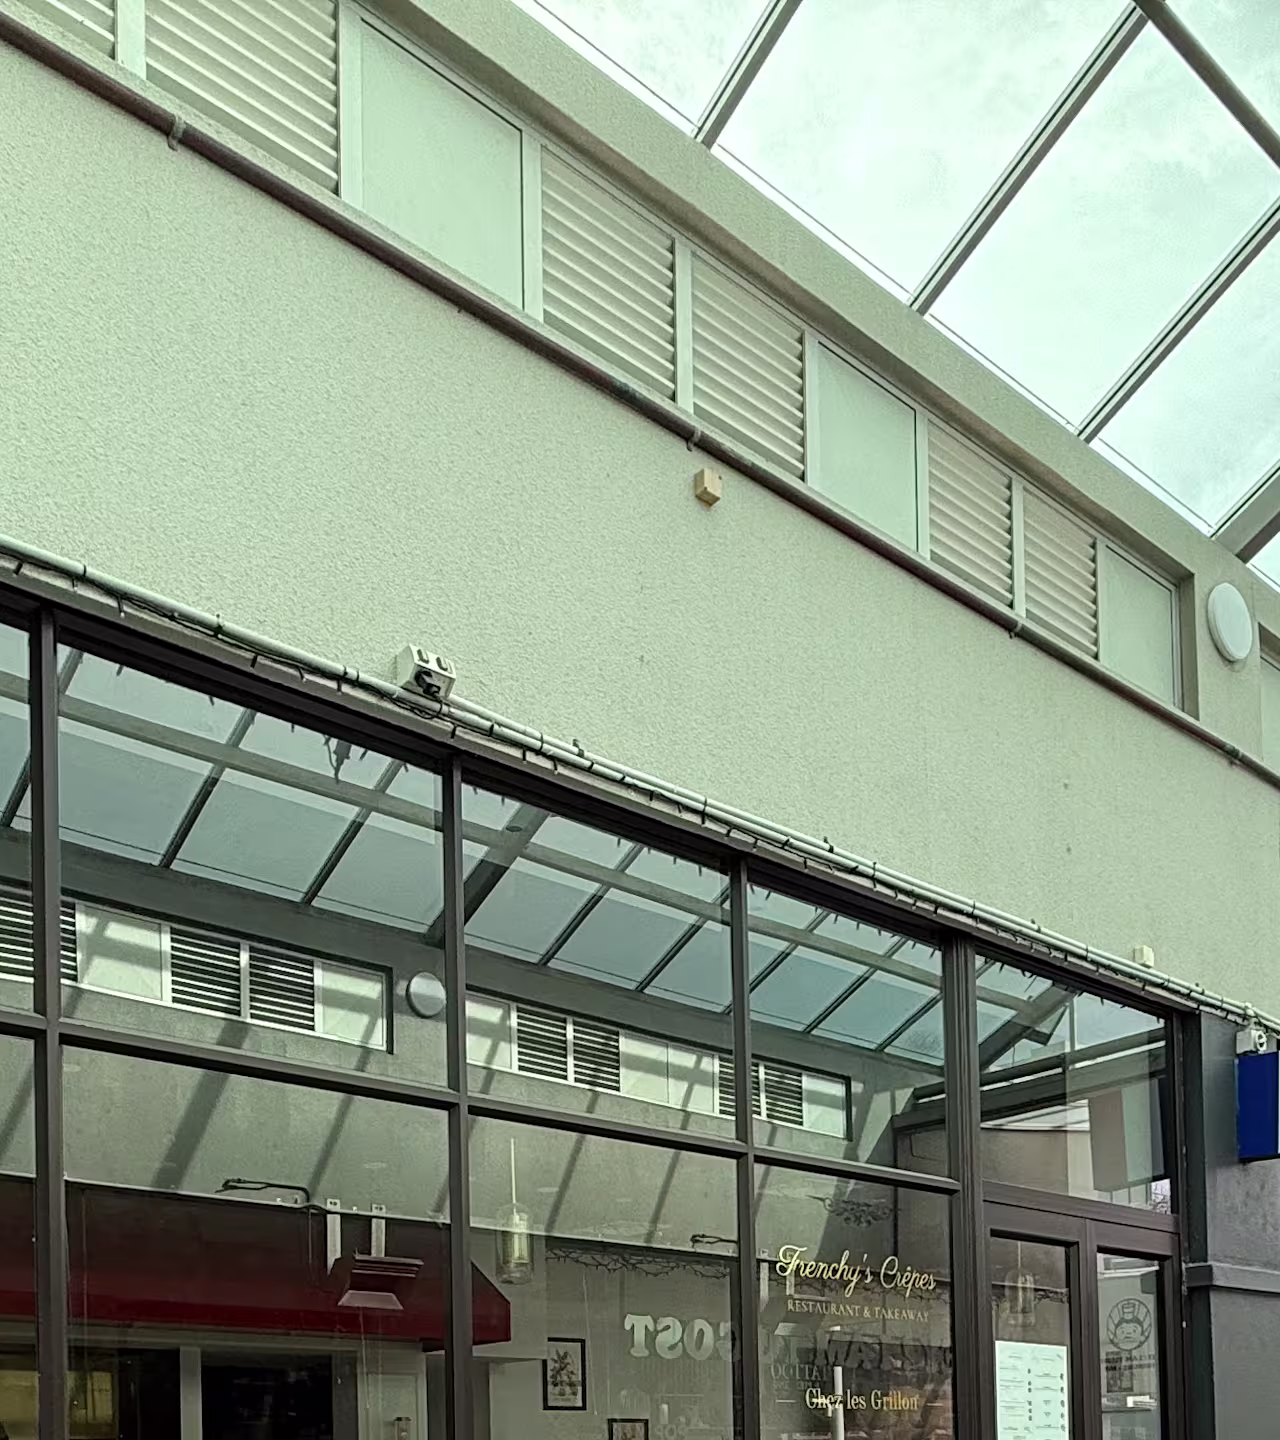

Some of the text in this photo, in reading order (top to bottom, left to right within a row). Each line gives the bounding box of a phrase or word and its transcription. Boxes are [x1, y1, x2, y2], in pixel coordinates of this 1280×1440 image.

[775, 1245, 937, 1298] Frenchy's Crêpes
[787, 1300, 930, 1322] RESTAURANT & TAKEAWAY
[805, 1387, 920, 1411] Chez les Grillon
